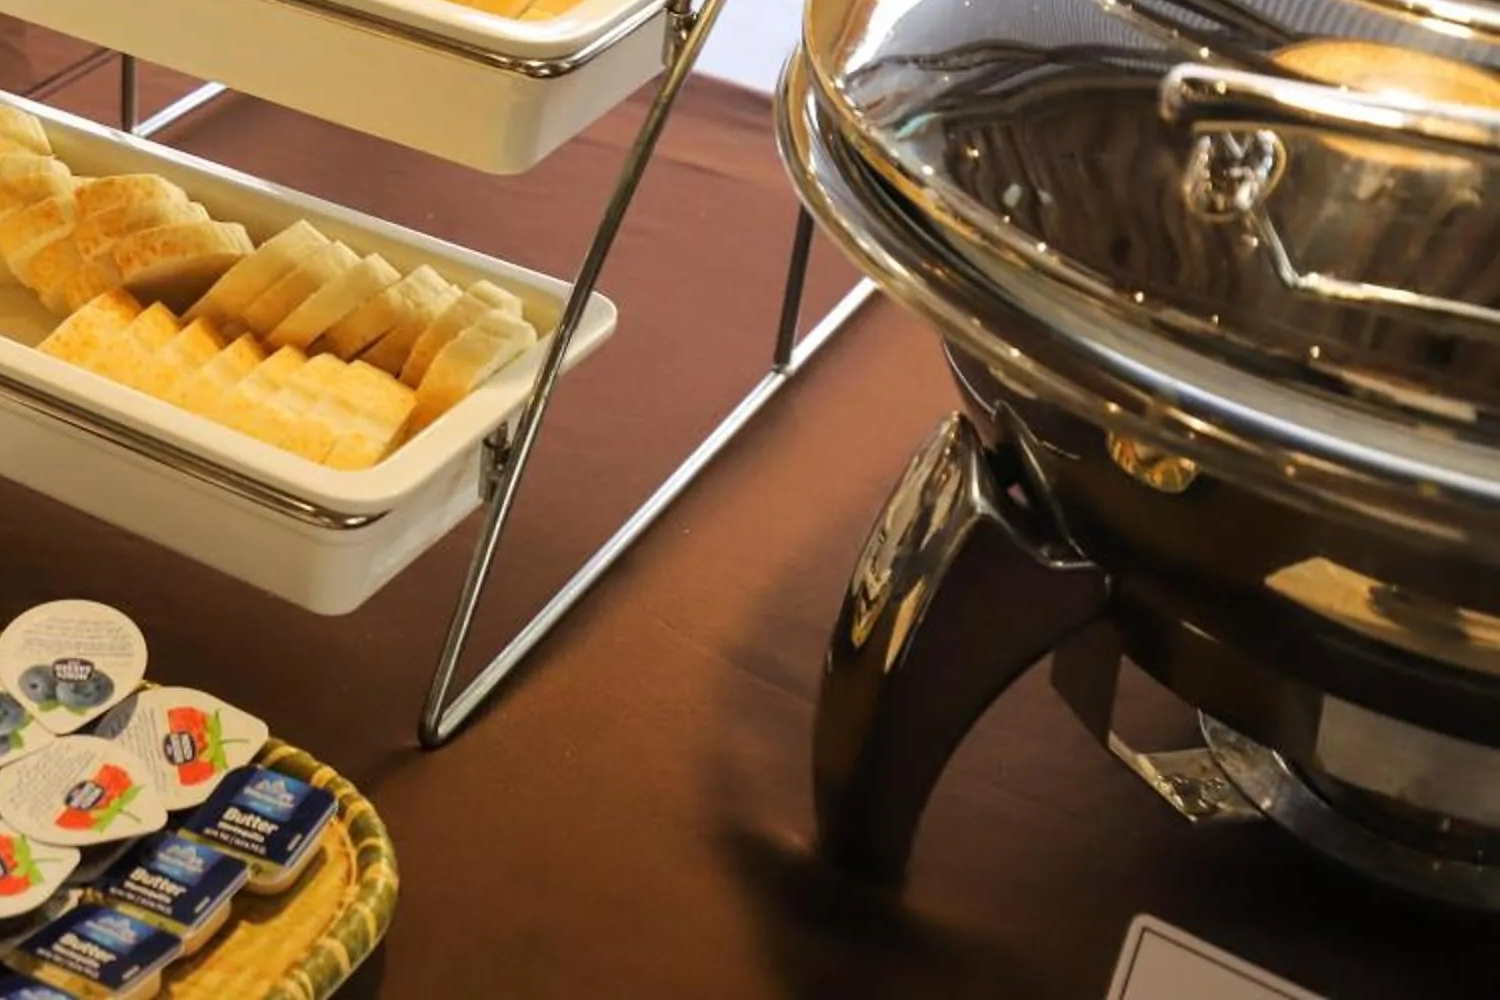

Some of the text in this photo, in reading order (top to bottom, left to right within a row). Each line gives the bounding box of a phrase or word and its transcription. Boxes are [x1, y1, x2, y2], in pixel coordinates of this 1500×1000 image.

[222, 806, 280, 836] Butter
[129, 865, 188, 897] Butter
[58, 931, 117, 963] Butter
